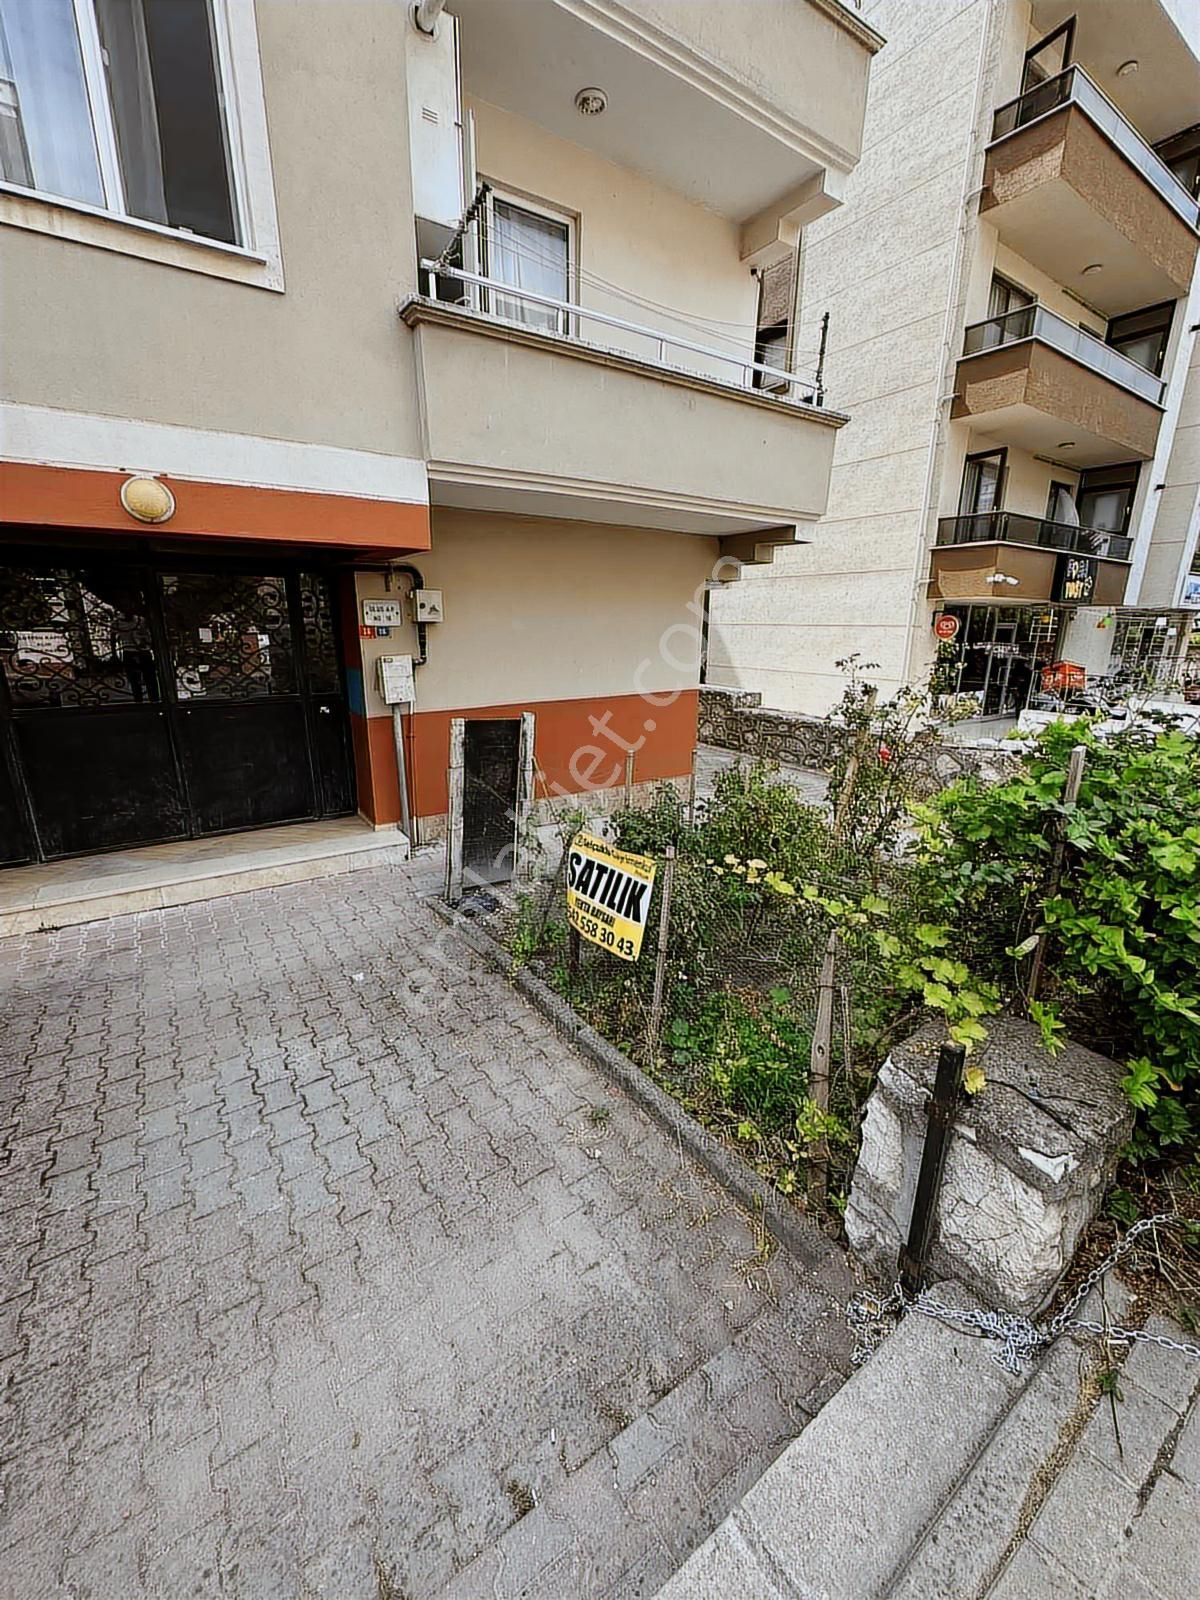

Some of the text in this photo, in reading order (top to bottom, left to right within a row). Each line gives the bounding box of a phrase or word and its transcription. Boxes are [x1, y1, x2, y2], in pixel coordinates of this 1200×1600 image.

[567, 851, 648, 924] SATILIK
[580, 915, 599, 938] 558
[599, 927, 615, 947] 30
[616, 937, 634, 956] 43
